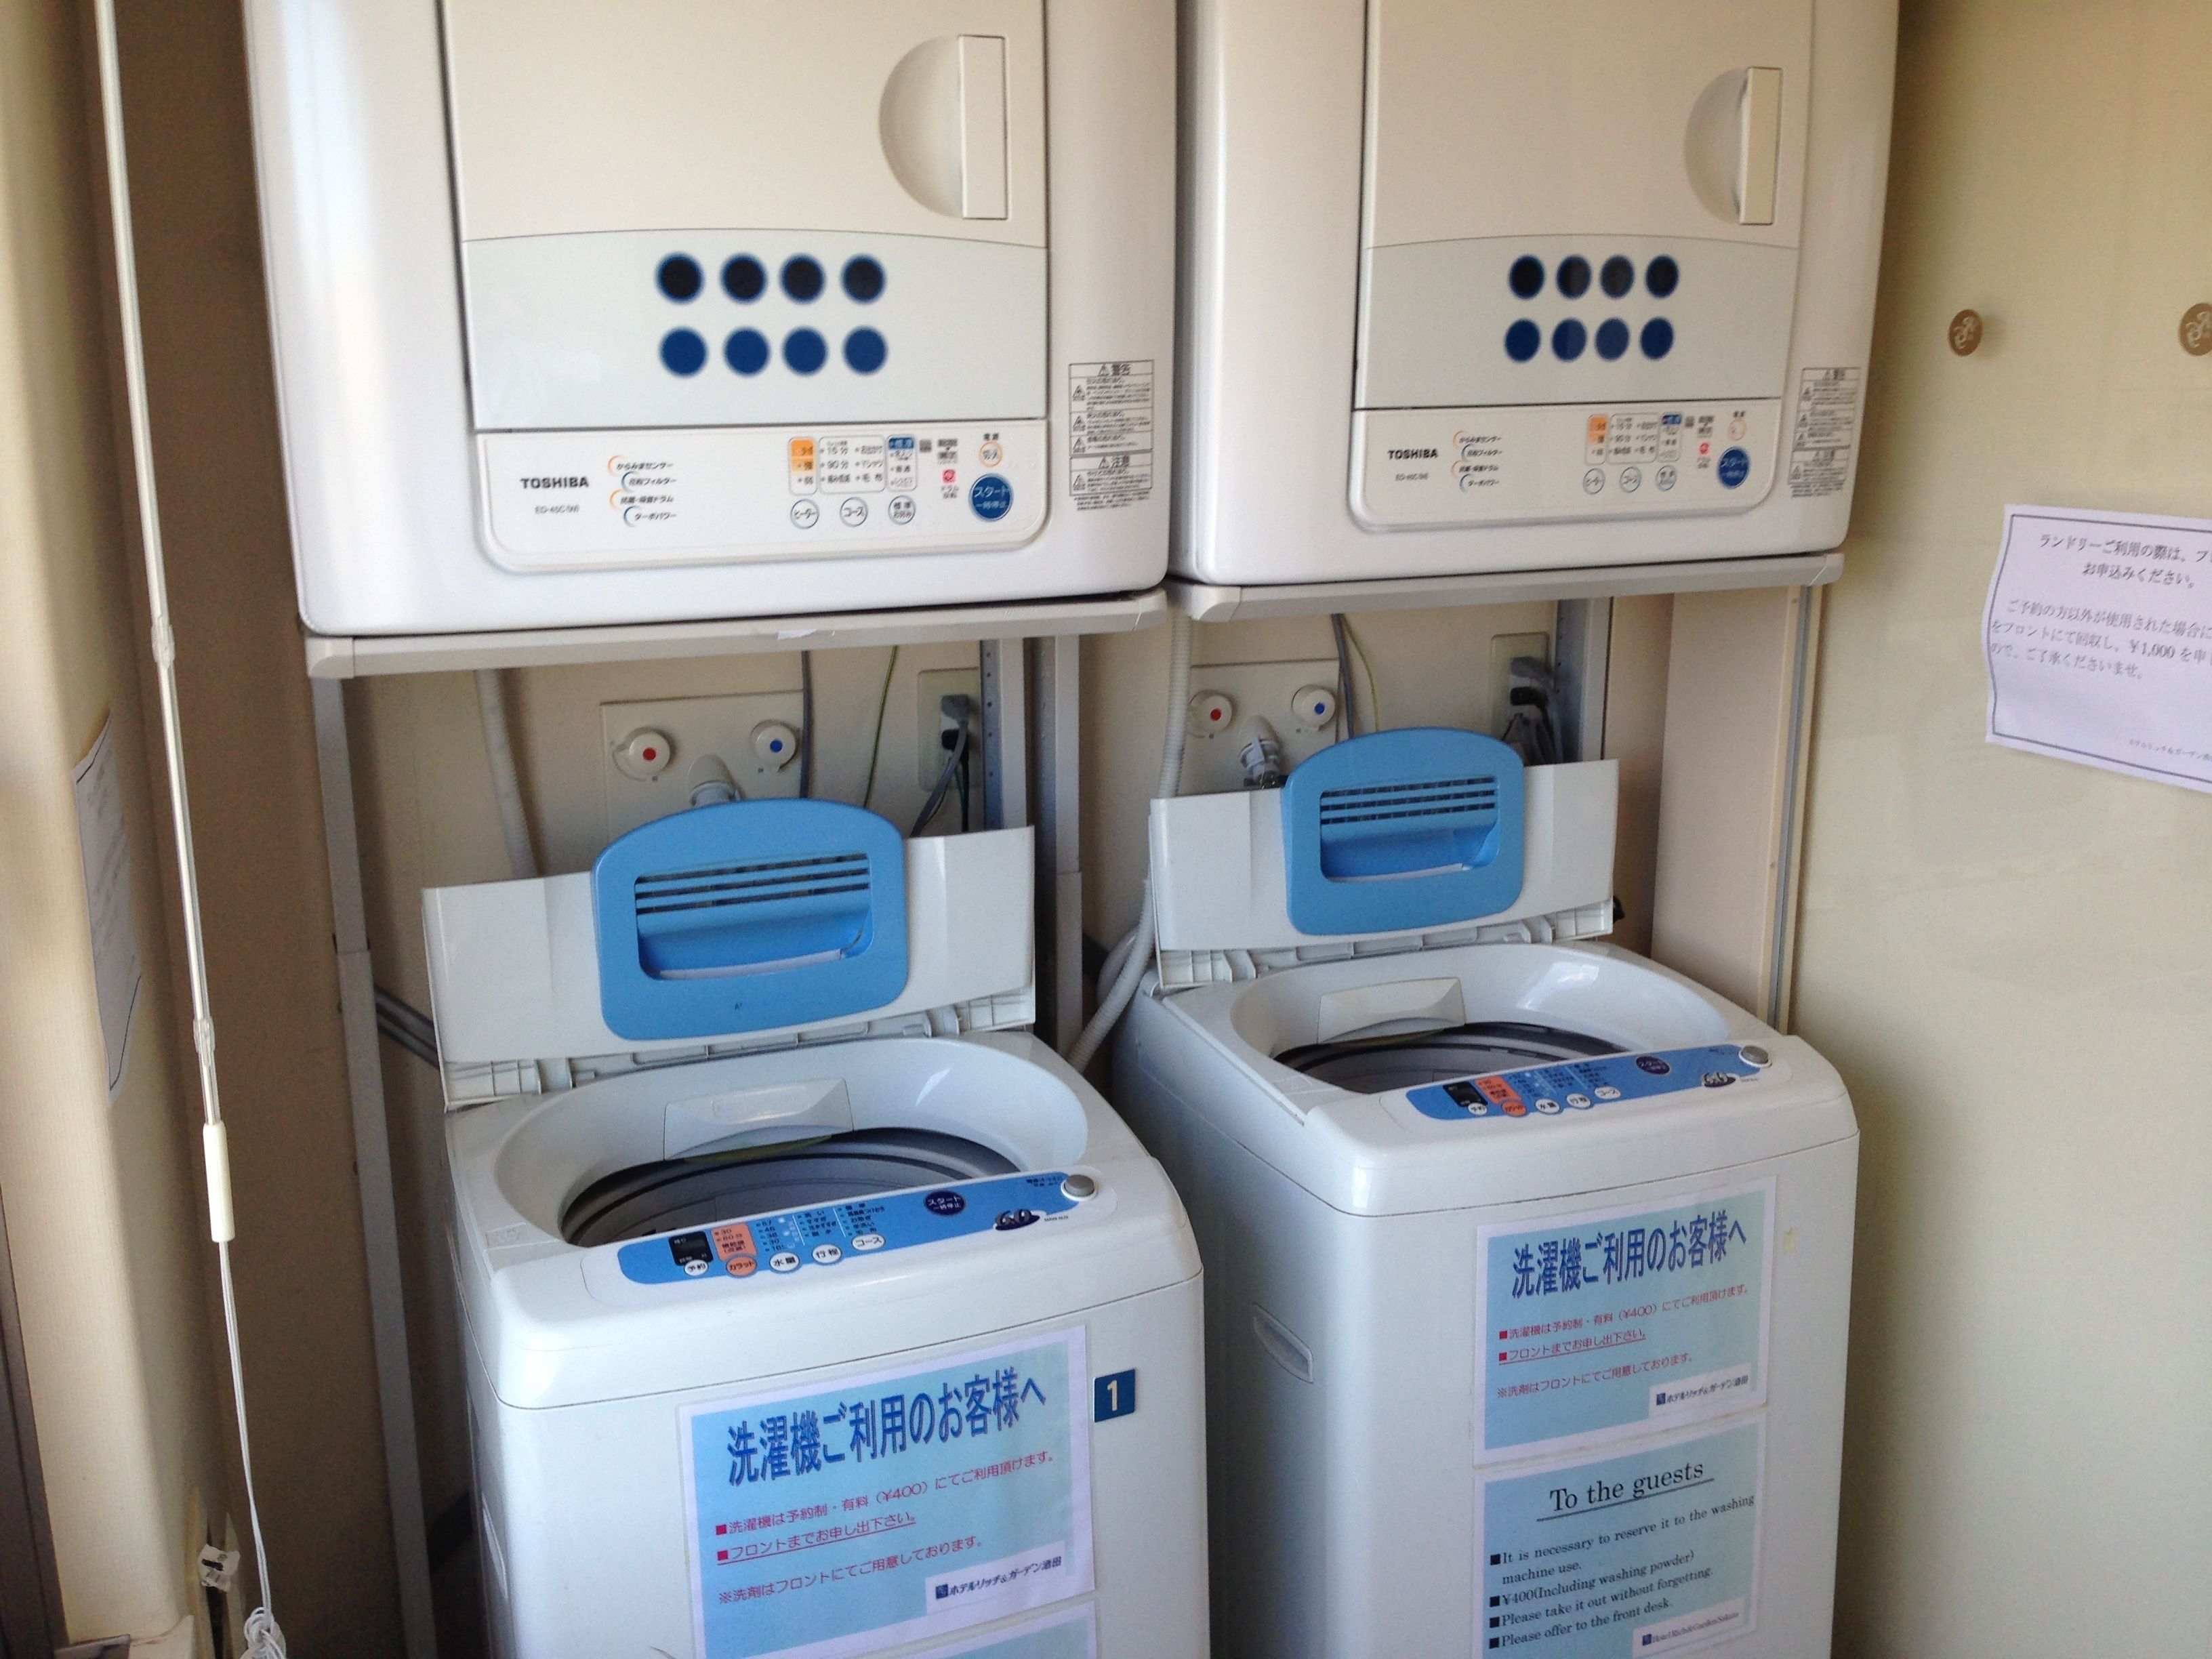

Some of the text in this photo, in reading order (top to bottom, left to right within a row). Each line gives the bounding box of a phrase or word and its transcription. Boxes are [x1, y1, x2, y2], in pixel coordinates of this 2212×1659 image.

[1387, 448, 1439, 459] TOSHIBA
[520, 476, 589, 489] TOSHIBA
[975, 485, 1010, 498] スタート
[2041, 533, 2212, 562] ランドリーご利用の際は、フ
[926, 1195, 961, 1206] スタート
[855, 1237, 882, 1247] コース
[1512, 1210, 1746, 1298] 洗濯機ご利用のお客様へ
[1509, 1328, 1646, 1361] フロントまでお申し出下さい。
[1106, 1379, 1118, 1412] 1
[726, 1366, 1046, 1487] 洗濯機ご利用のお客様へ
[1549, 1462, 1704, 1512] To the guests
[730, 1511, 917, 1561] フロントまでお申し出下さい。
[1502, 1493, 1756, 1563] It is necessary to reserve it to the washing
[1502, 1561, 1582, 1585] machine use.
[1599, 1565, 1647, 1587] washing
[1650, 1549, 1695, 1576] powder)
[1502, 1612, 1542, 1628] Please
[1544, 1603, 1572, 1618] take
[1576, 1600, 1584, 1612] it
[1587, 1596, 1607, 1609] out
[1611, 1582, 1656, 1603] without
[1502, 1633, 1541, 1648] Please
[1544, 1622, 1573, 1639] offer
[1576, 1620, 1588, 1633] to
[1591, 1614, 1610, 1629] the
[1613, 1606, 1641, 1622] front
